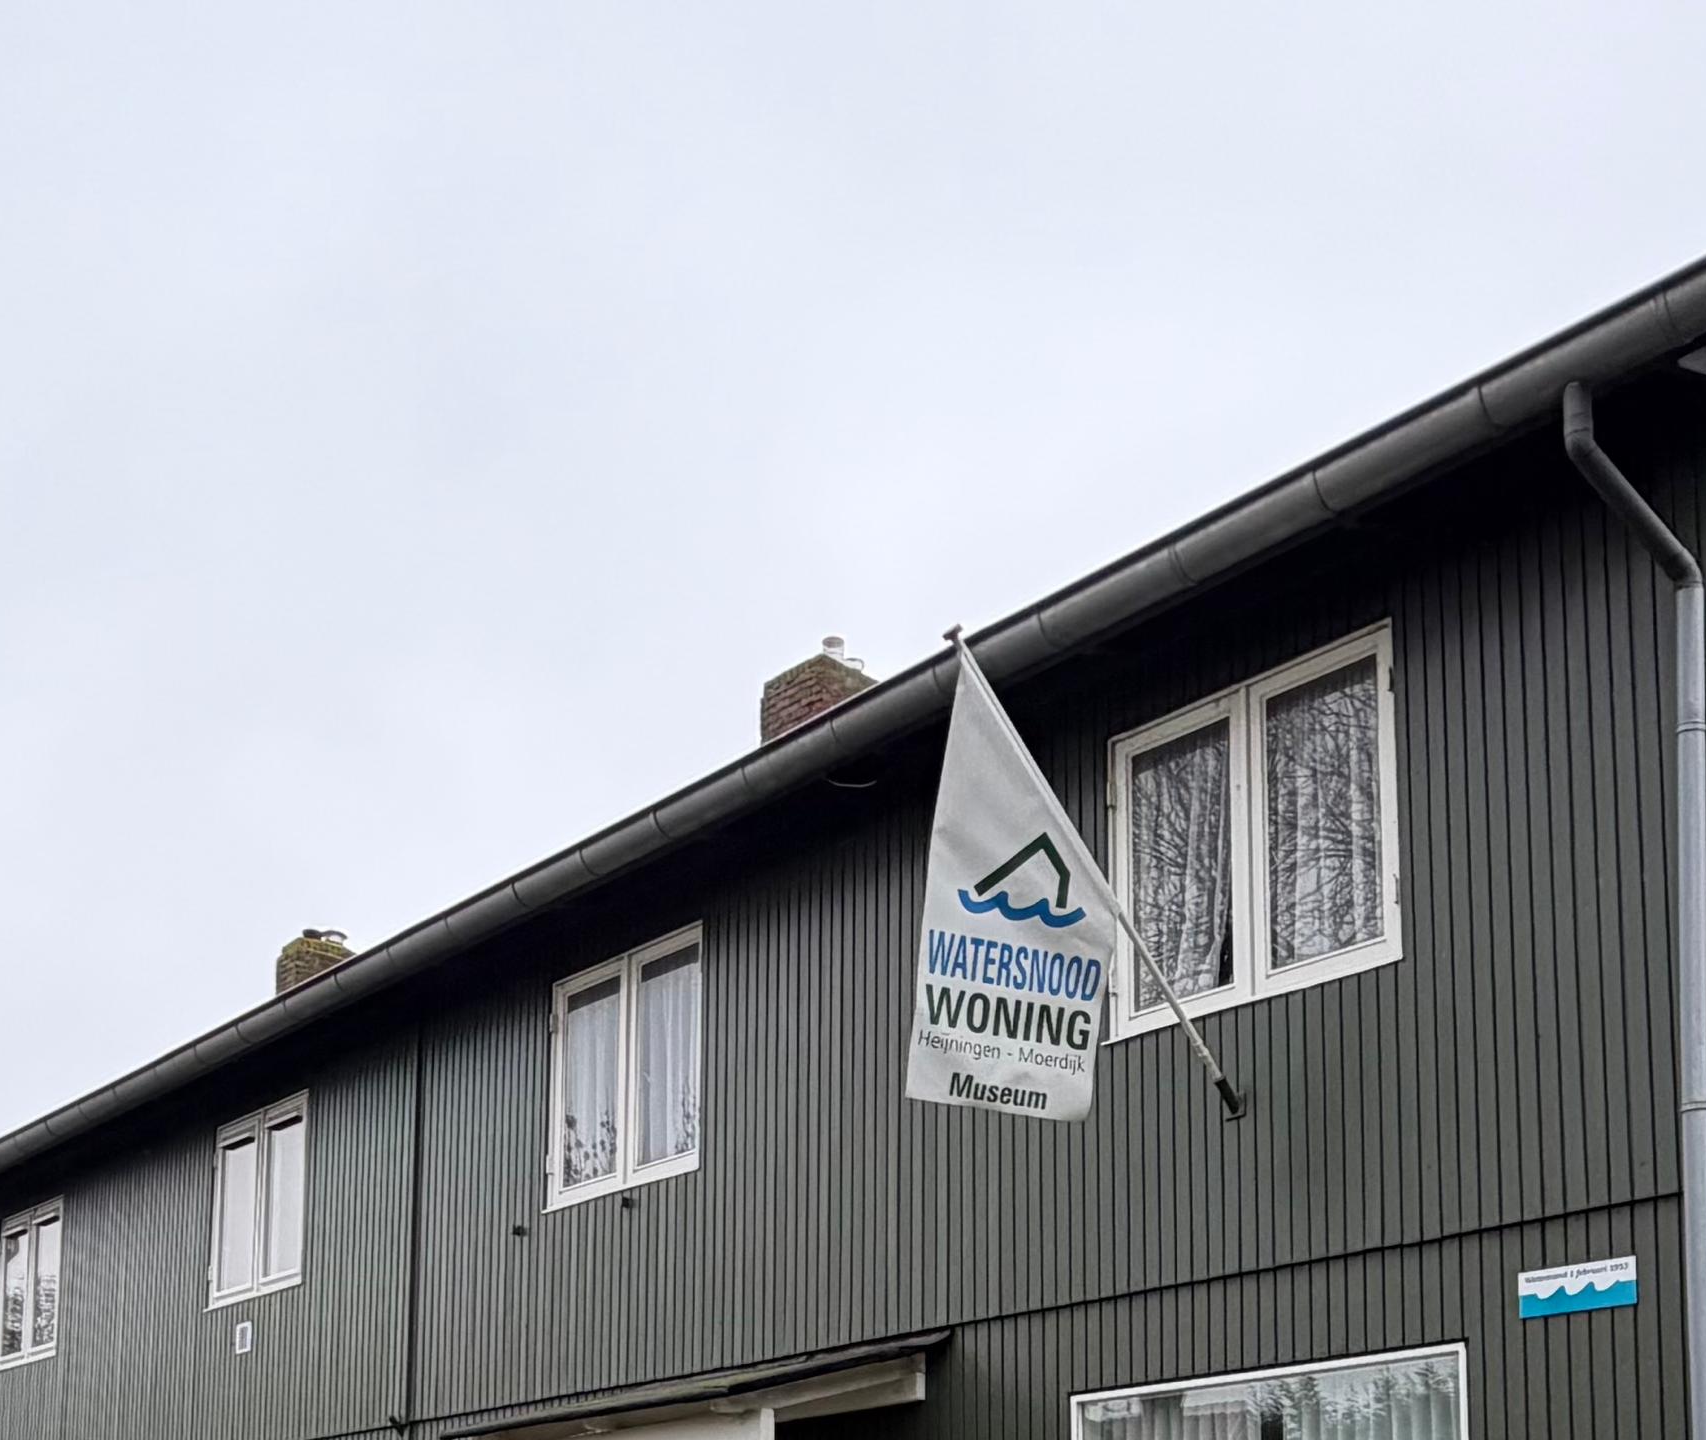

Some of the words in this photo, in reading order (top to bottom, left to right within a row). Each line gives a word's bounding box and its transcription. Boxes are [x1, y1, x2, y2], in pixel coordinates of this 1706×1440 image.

[928, 929, 1102, 1002] WATERSNOOD
[925, 983, 1092, 1050] WONING
[917, 1029, 1001, 1061] Heijningen
[1018, 1046, 1086, 1075] Moerdijk
[949, 1072, 1048, 1110] Museum
